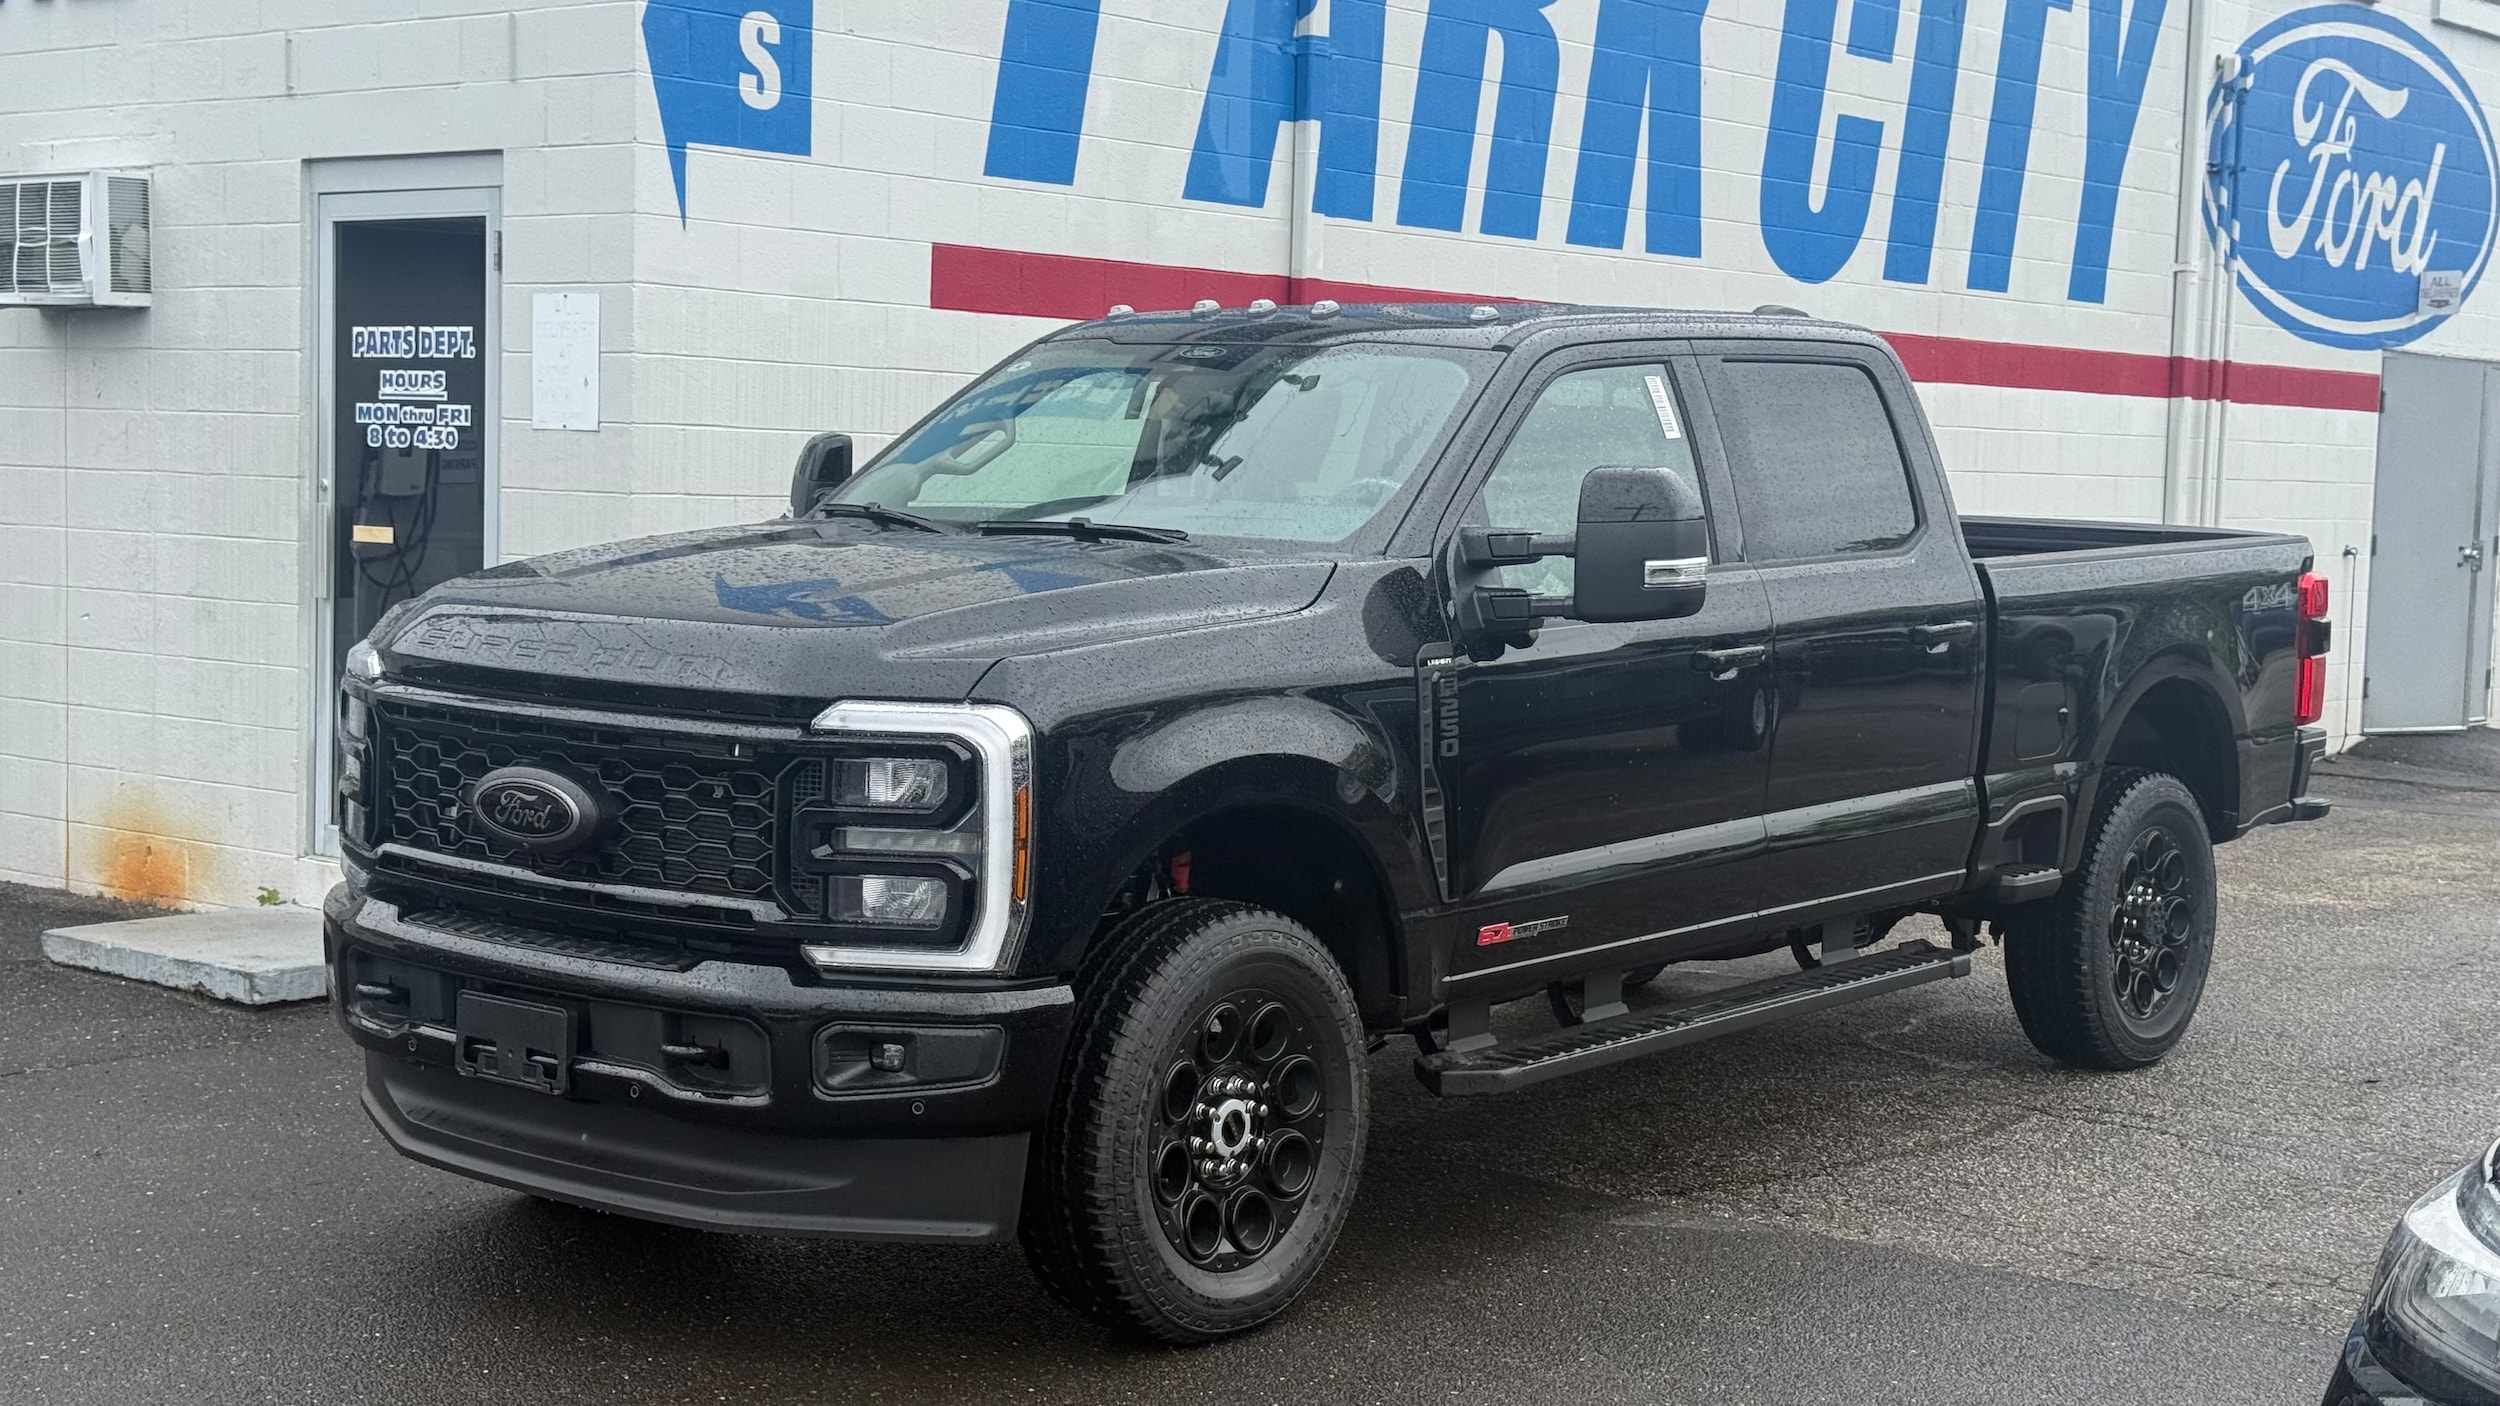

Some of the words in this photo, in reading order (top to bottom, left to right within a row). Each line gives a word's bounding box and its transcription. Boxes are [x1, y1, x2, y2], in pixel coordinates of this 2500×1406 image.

[739, 11, 781, 110] S
[1760, 0, 2168, 305] CITY
[2267, 57, 2446, 278] Ford
[2431, 276, 2452, 287] ALL
[352, 326, 415, 358] PARTS
[418, 326, 476, 358] DEPT.
[379, 370, 446, 392] HOURS
[355, 403, 400, 424] MON
[400, 406, 435, 424] thru
[436, 404, 471, 426] FRI
[367, 425, 382, 447] 8
[385, 425, 410, 447] to
[413, 426, 458, 449] 4:30
[495, 790, 552, 829] Ford
